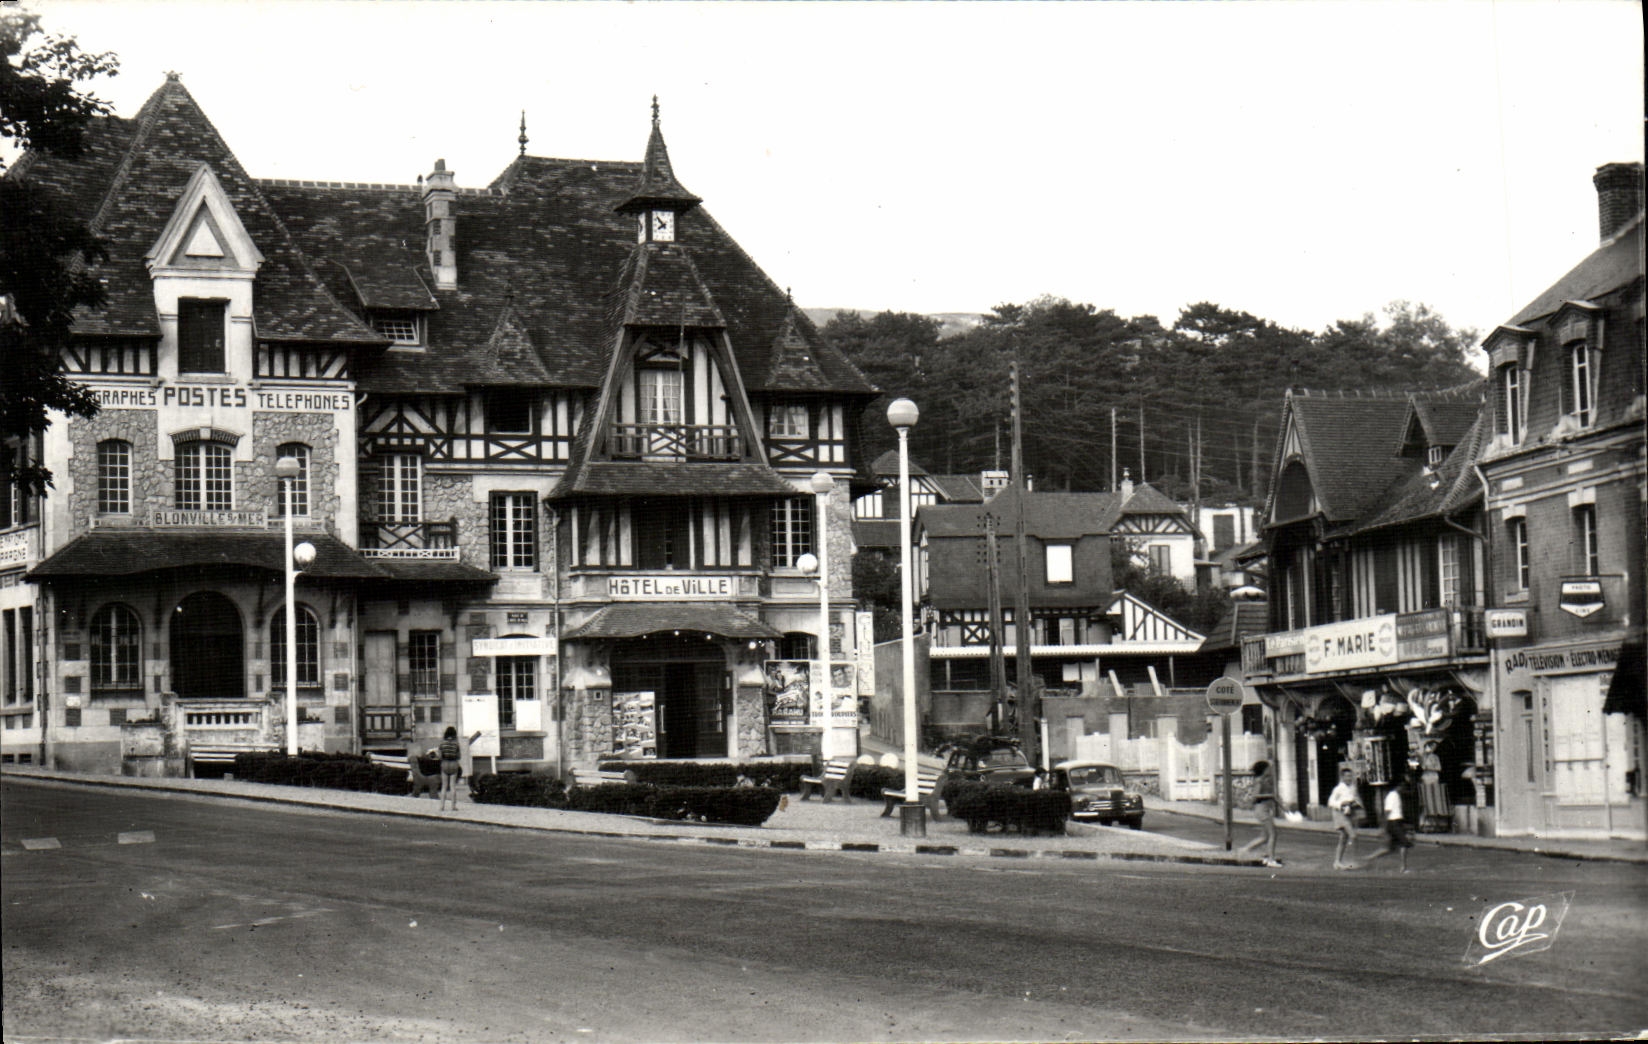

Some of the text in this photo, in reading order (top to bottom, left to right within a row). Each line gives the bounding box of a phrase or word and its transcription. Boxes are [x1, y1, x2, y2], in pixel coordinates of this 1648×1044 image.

[94, 390, 156, 405] GRAPHES
[163, 387, 247, 407] POSTES
[257, 393, 350, 410] TELEPHONES
[155, 512, 225, 525] BLONVILLE
[665, 586, 681, 594] DE
[1491, 618, 1524, 629] GRANDIN
[1337, 632, 1376, 656] MARIE
